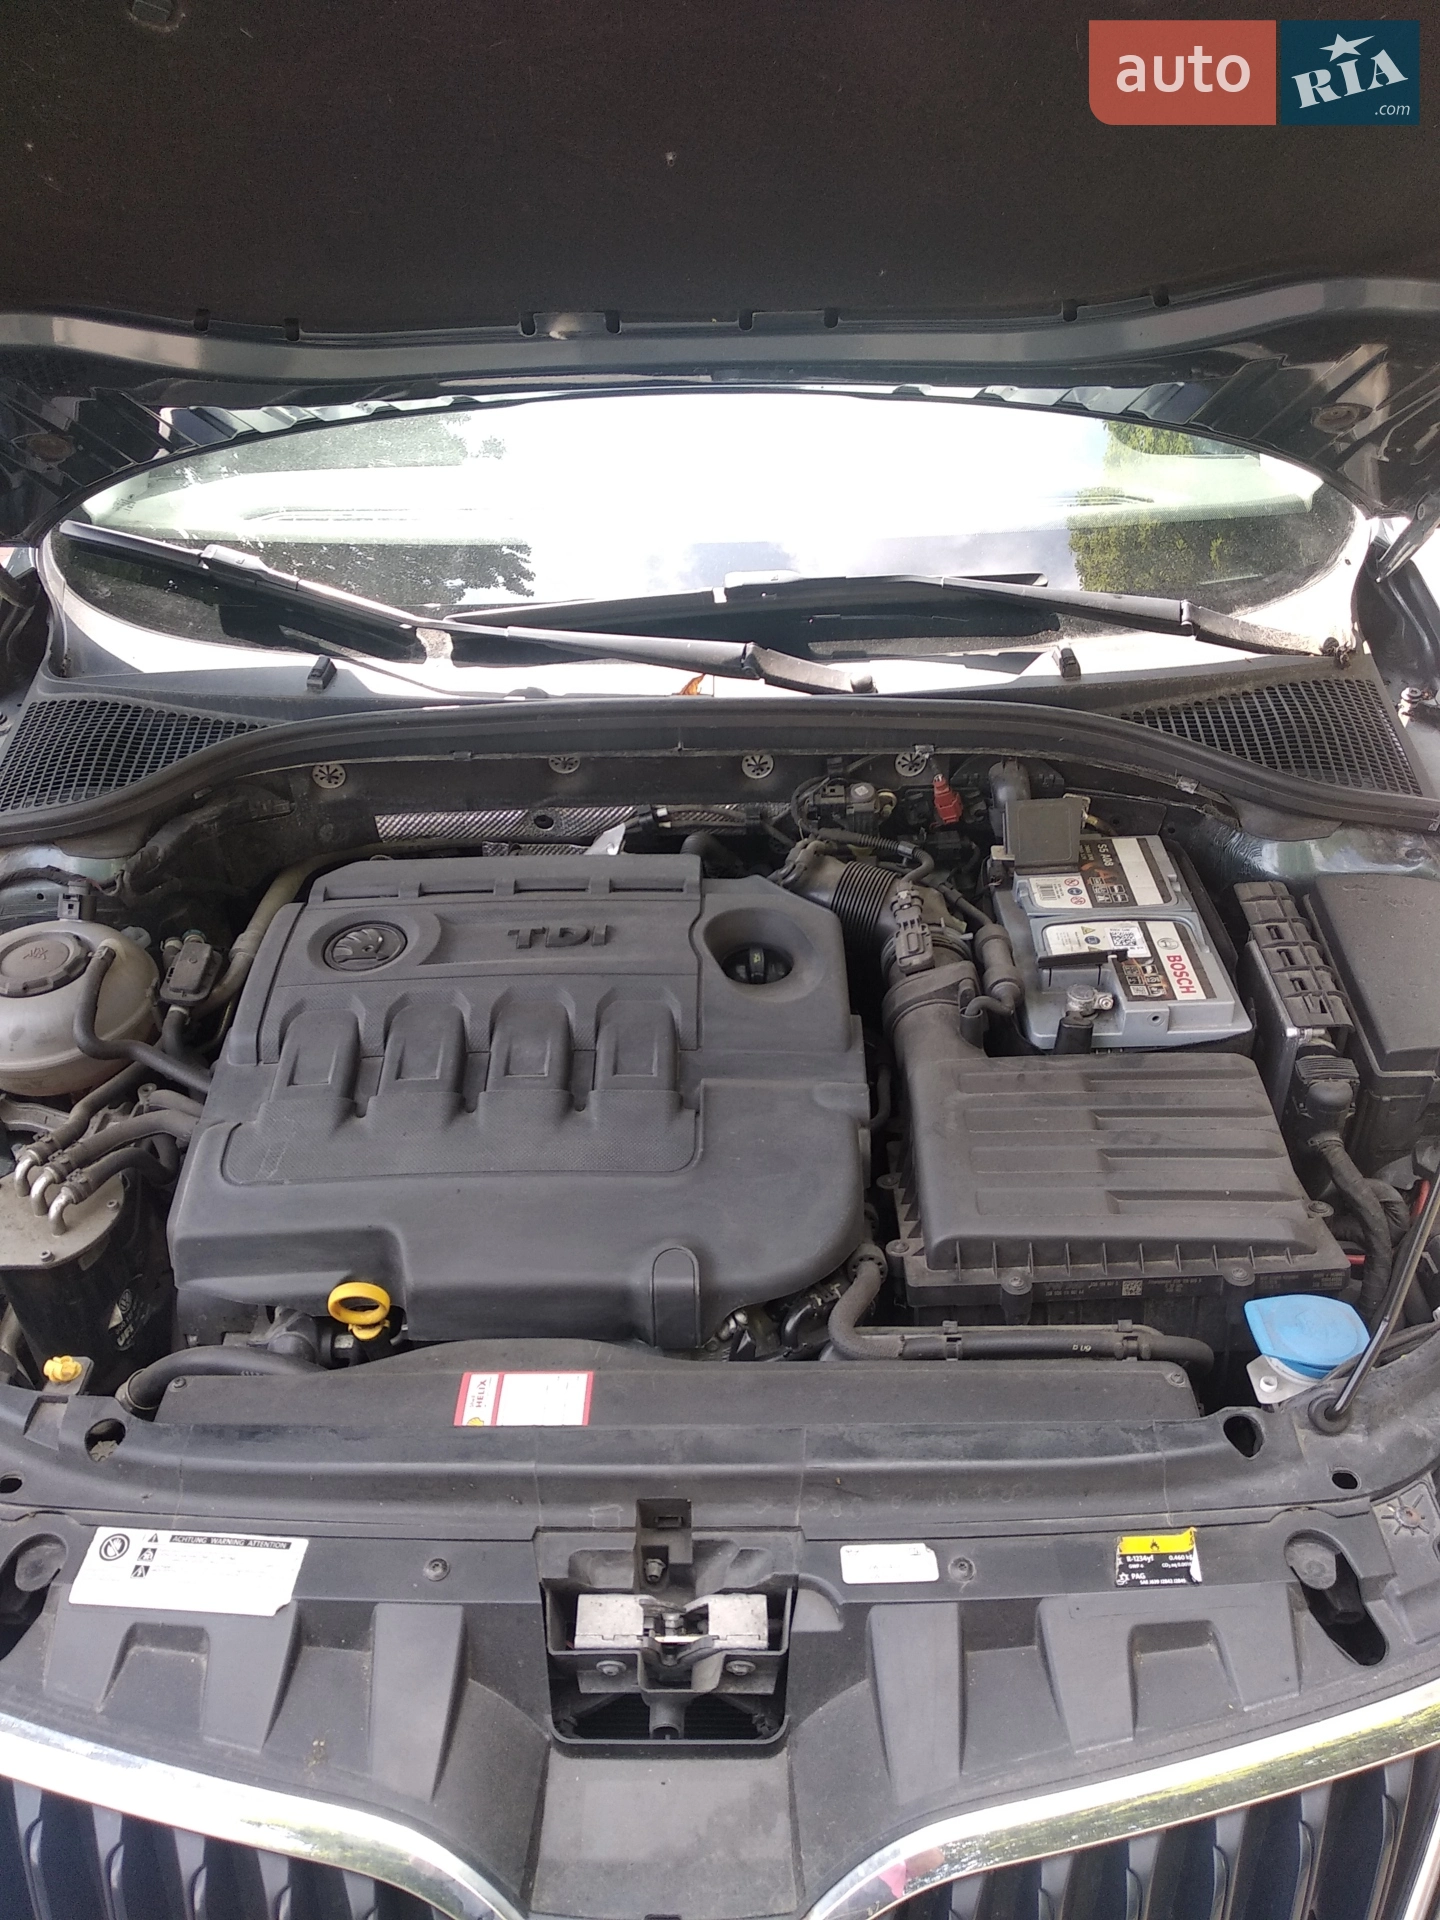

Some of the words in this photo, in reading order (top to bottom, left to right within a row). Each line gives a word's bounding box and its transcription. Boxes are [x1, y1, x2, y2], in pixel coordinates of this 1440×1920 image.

[507, 923, 612, 950] TDI
[1166, 954, 1197, 994] BOSCH
[475, 1379, 487, 1408] HELIX
[172, 1535, 207, 1544] ACHTUNG
[210, 1537, 245, 1546] WARNING
[247, 1540, 287, 1549] ATTENTION
[1126, 1555, 1154, 1564] R-1234yf
